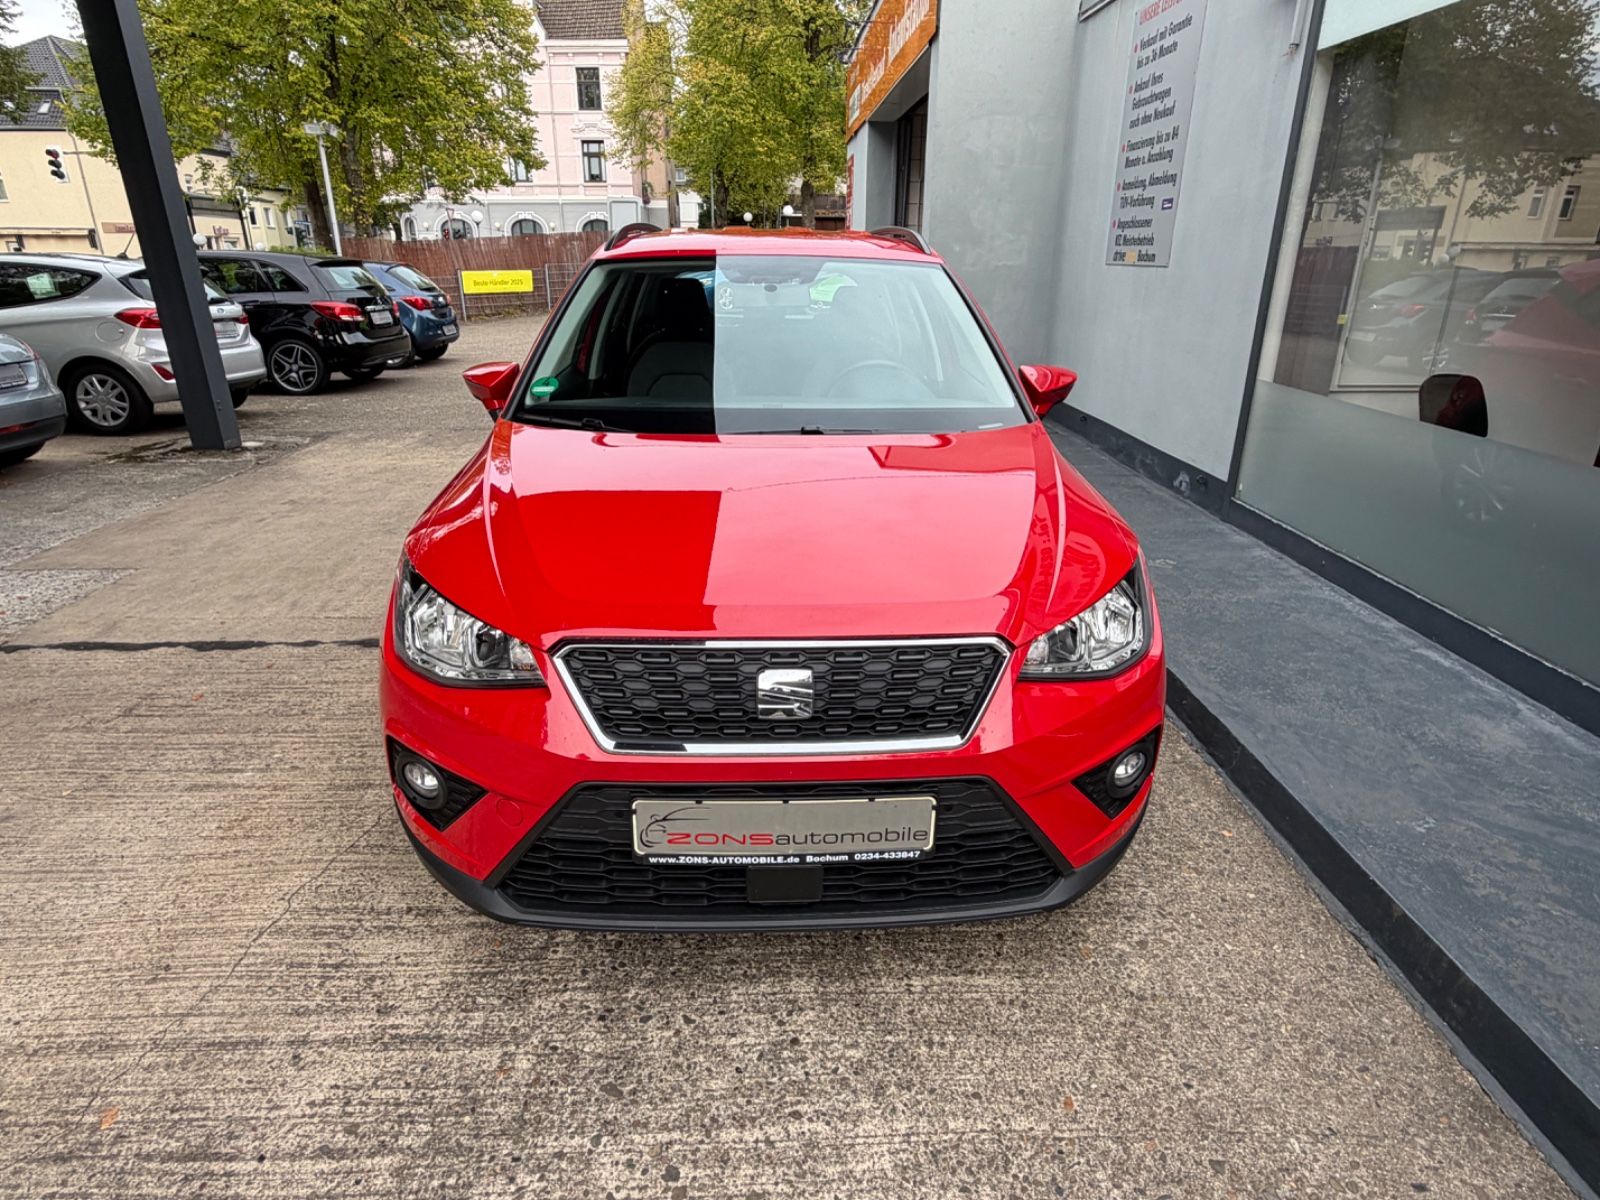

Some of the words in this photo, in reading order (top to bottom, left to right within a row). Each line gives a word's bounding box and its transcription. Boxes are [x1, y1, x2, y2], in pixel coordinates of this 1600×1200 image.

[1140, 28, 1159, 52] Verkauf
[1159, 26, 1168, 41] mit
[1168, 12, 1193, 36] Garantie
[1144, 55, 1150, 66] zu
[1151, 47, 1158, 63] 36
[1158, 40, 1178, 59] Monate
[1134, 72, 1151, 94] Ankauf
[1151, 72, 1164, 87] Ihres
[1132, 87, 1172, 111] Gebrauchtwagen
[1129, 113, 1140, 129] auch
[1140, 111, 1153, 125] ohne
[1153, 99, 1176, 121] Neukauf
[1126, 136, 1155, 152] Finanzierung
[1156, 130, 1164, 145] bis
[1164, 132, 1171, 142] zu
[1125, 155, 1141, 168] Monate
[1147, 146, 1174, 163] Anzahlung
[1148, 170, 1177, 187] Abmeldung
[1117, 215, 1153, 232] Angeschlossener
[1123, 232, 1154, 246] Meisterbetrieb
[1137, 249, 1156, 262] Bochum
[666, 827, 928, 846] ZONSautomobile
[649, 856, 800, 864] www.ZONS-AUTOMOBILE.de
[806, 854, 848, 863] Bochum
[854, 851, 921, 861] 0234-433847
